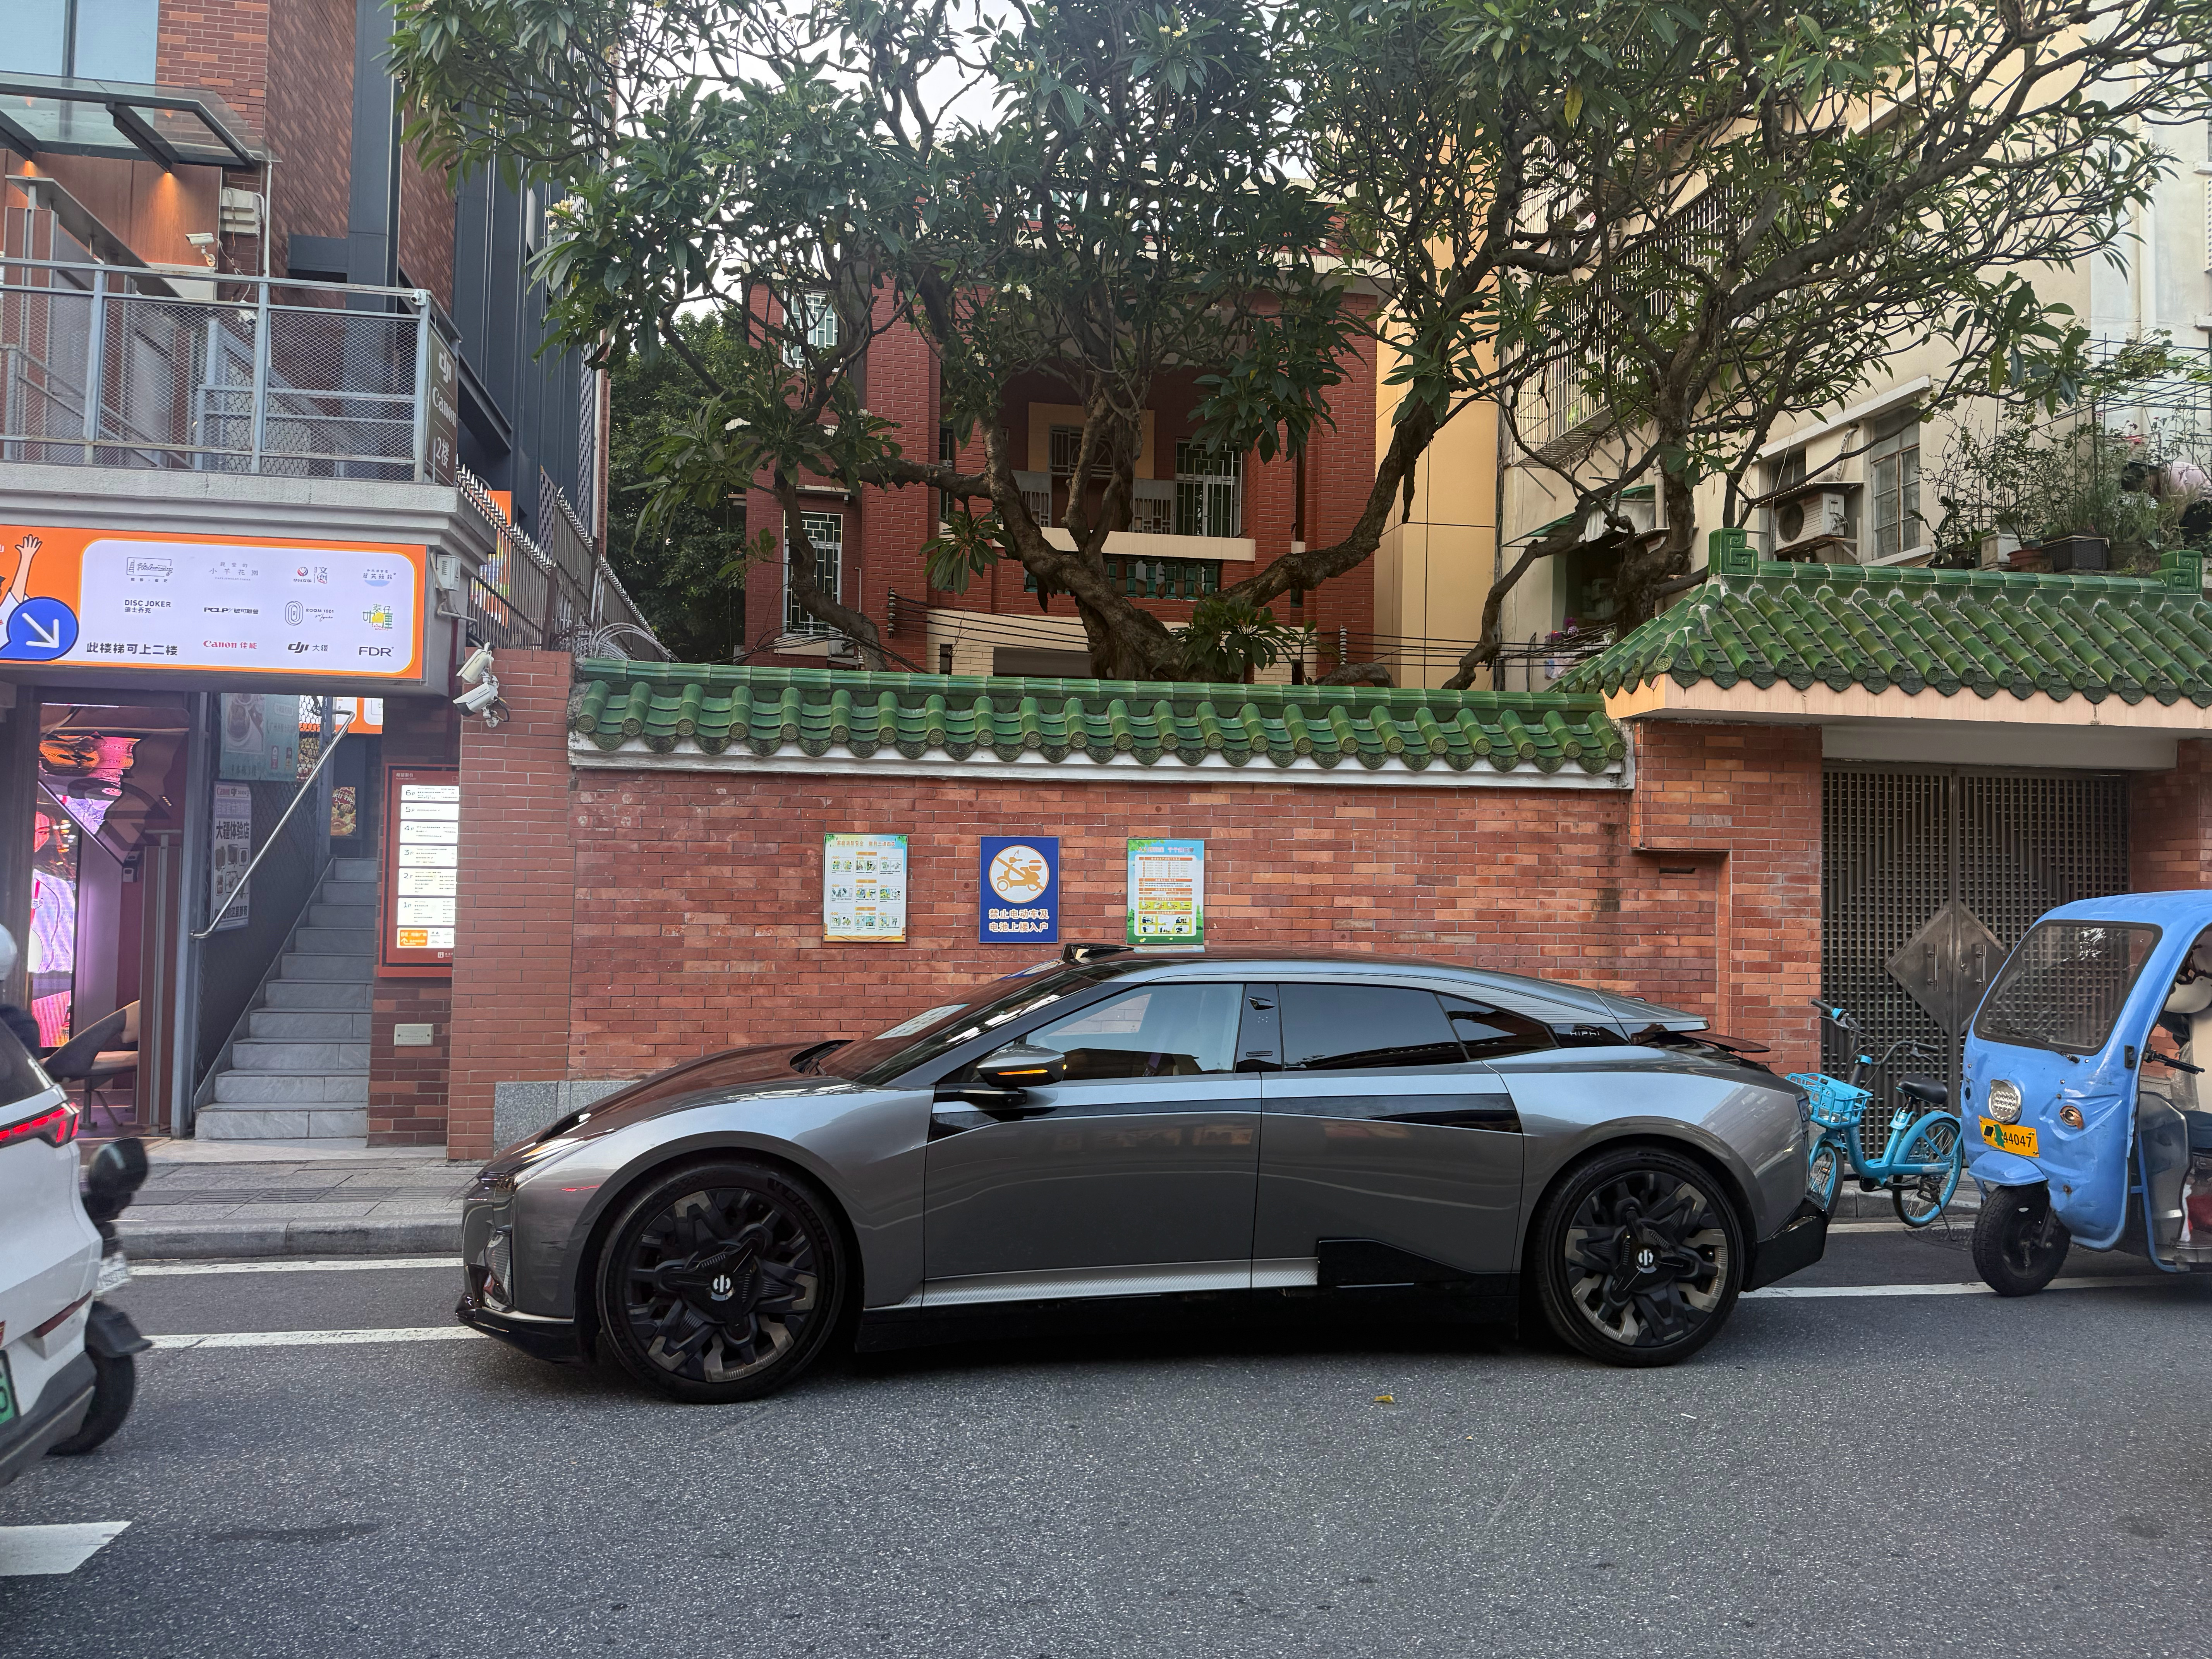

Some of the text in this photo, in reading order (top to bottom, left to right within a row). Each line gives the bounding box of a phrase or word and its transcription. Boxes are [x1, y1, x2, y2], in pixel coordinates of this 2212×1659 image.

[433, 387, 456, 428] Canon
[436, 436, 449, 469] 2楼
[86, 642, 177, 655] 此楼梯可上二楼
[216, 820, 249, 840] 大疆体验店
[989, 908, 1049, 919] 禁止电动车及
[989, 922, 1048, 933] 电池上楼入户
